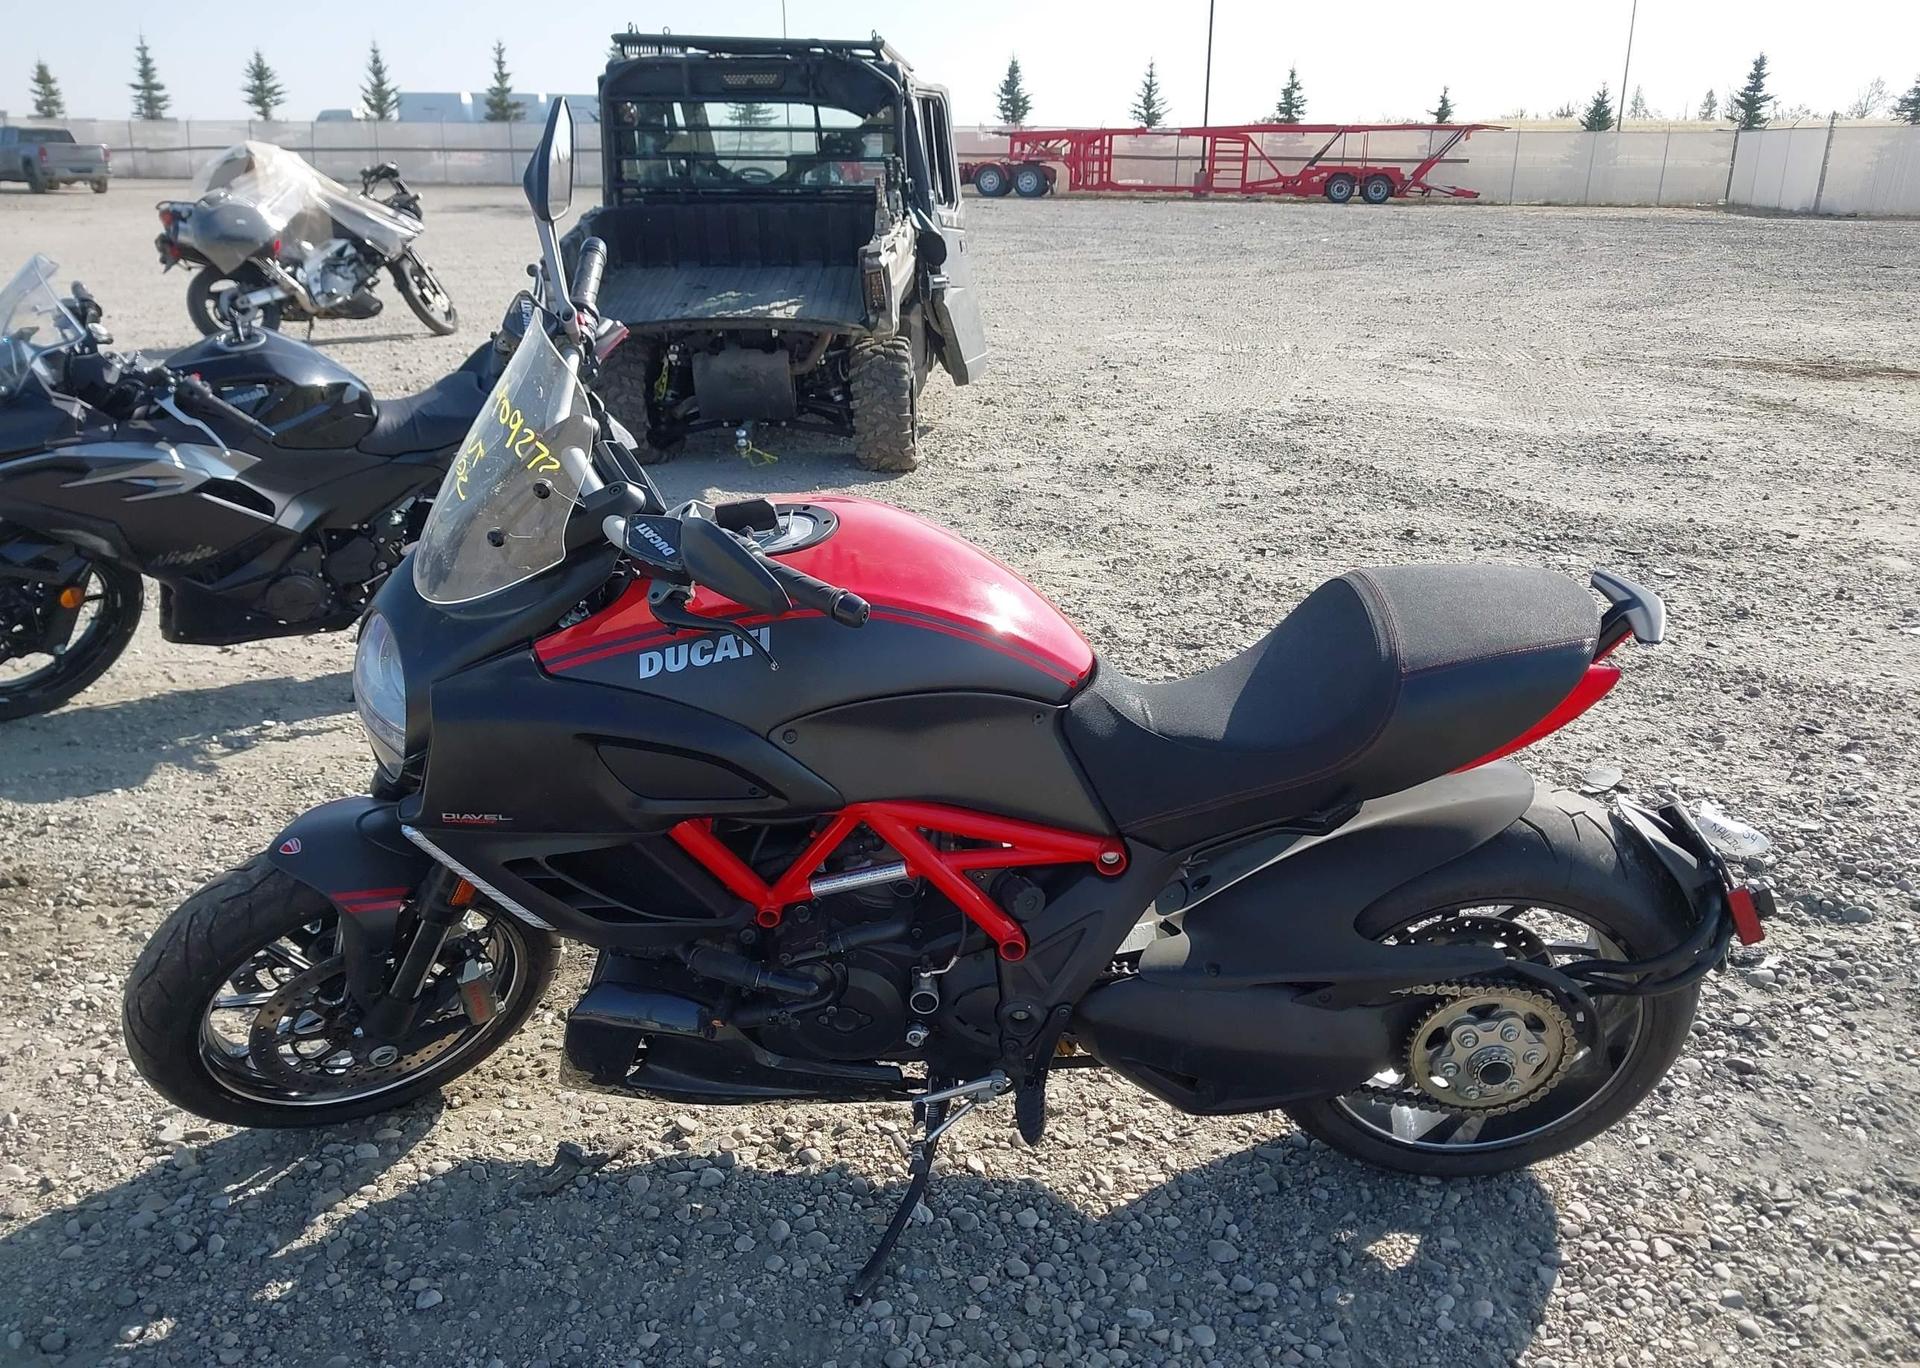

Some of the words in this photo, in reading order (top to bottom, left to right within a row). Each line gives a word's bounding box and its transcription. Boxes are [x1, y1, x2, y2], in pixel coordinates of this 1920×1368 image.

[635, 523, 676, 557] DUCATI
[639, 626, 770, 679] DUCATI
[441, 812, 514, 821] DIAVEL
